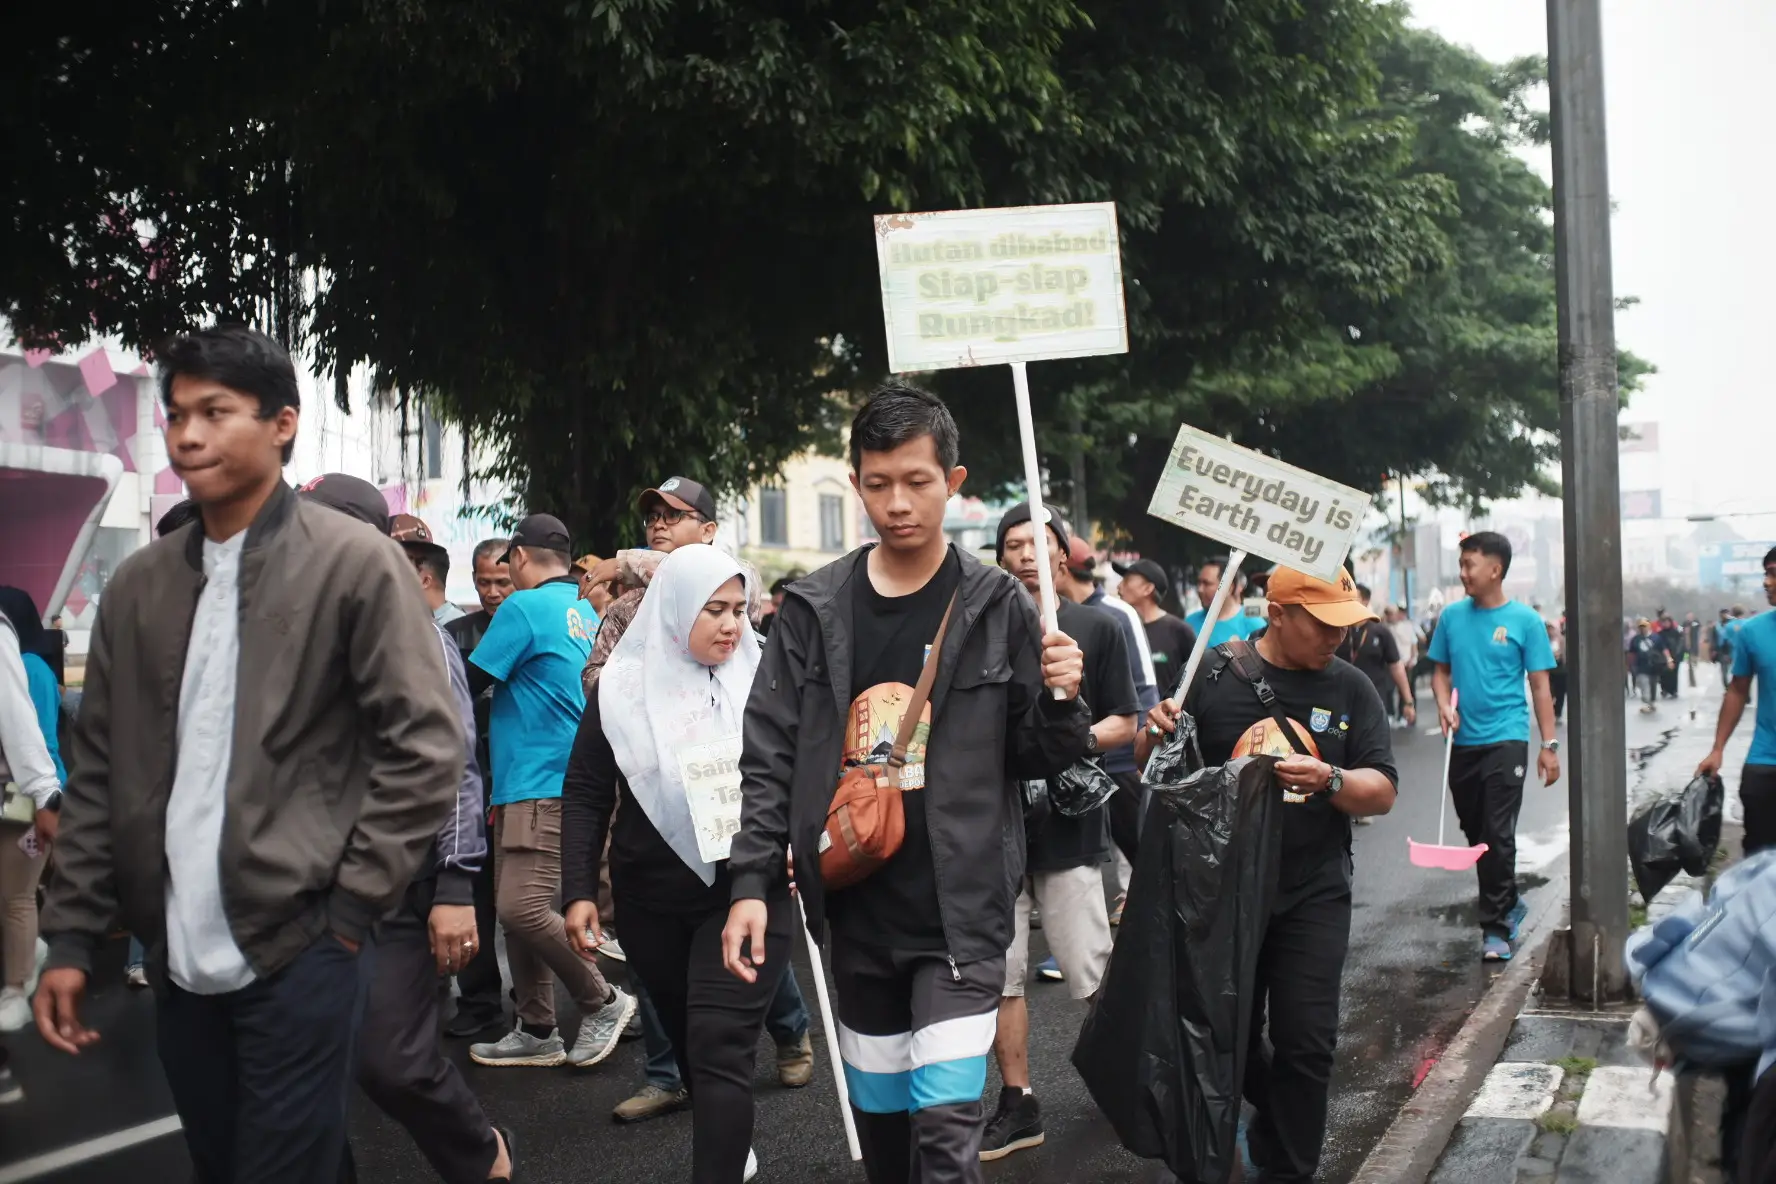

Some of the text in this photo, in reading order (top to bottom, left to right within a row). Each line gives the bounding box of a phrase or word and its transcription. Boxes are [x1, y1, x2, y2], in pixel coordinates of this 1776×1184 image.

[918, 265, 1088, 302] Siap-siap
[1177, 446, 1353, 530] Everyday is
[1179, 485, 1324, 563] Earth day
